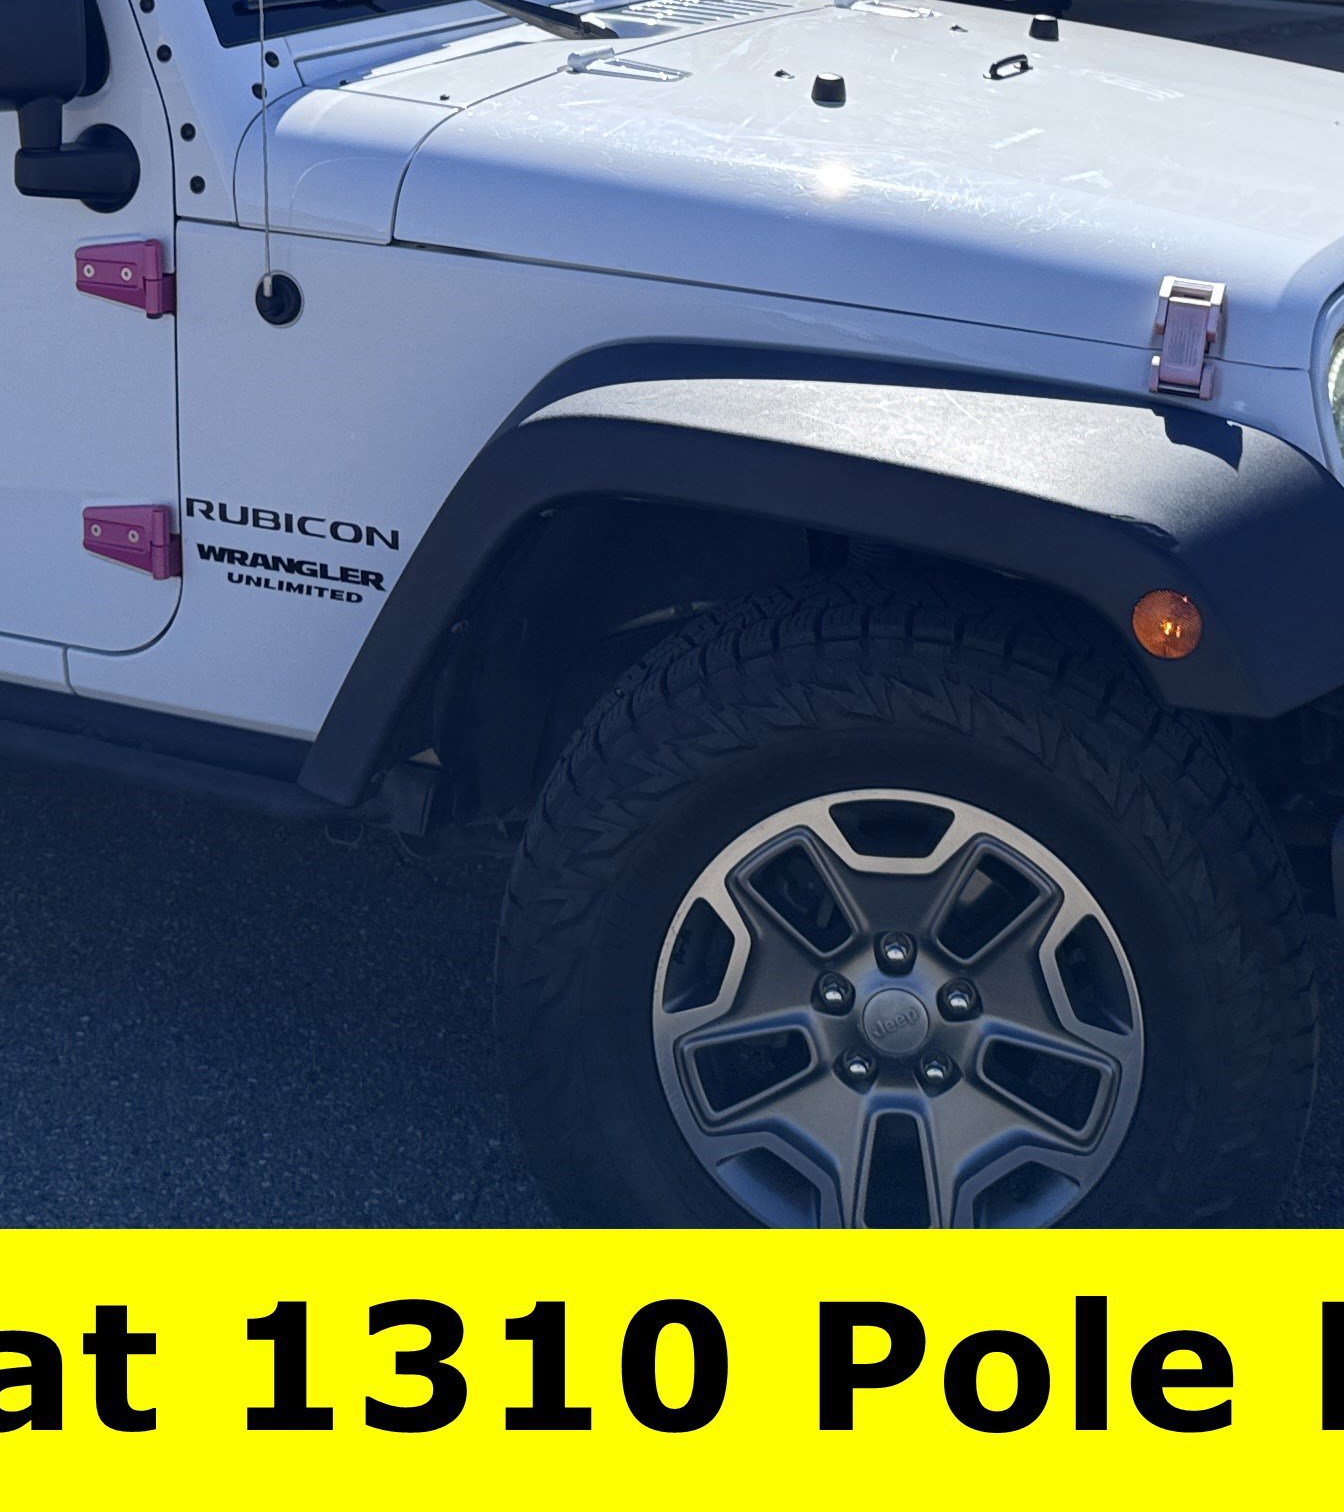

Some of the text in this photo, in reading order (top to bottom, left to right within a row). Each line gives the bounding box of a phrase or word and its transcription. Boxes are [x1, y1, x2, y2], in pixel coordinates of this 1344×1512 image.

[186, 497, 400, 551] RUBICON
[197, 543, 387, 592] WRANGLER
[227, 571, 363, 604] UNLIMITED
[872, 1006, 918, 1039] Jeep
